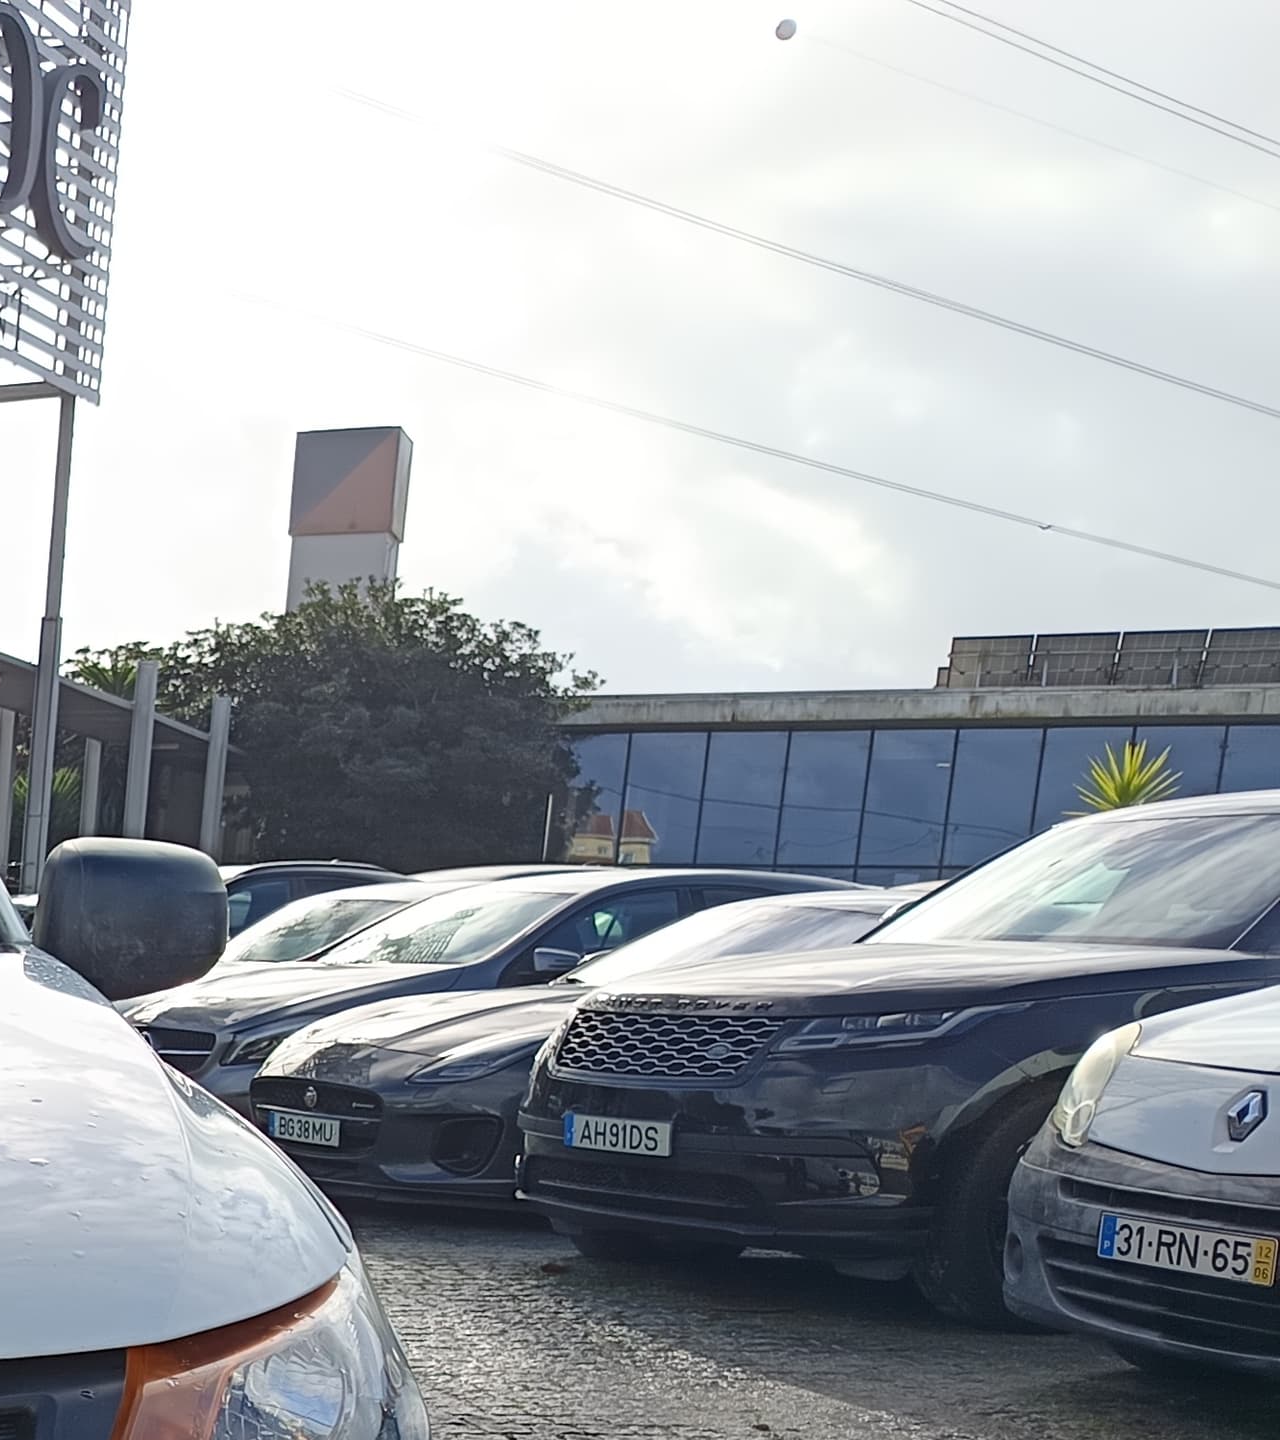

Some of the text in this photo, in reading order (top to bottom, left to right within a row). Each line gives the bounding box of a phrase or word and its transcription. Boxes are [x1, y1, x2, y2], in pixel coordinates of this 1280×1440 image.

[279, 1116, 334, 1143] BG38MU
[580, 1119, 659, 1152] AH91DS
[1103, 1240, 1111, 1250] P
[1258, 1245, 1272, 1258] 12
[1254, 1267, 1269, 1279] 06
